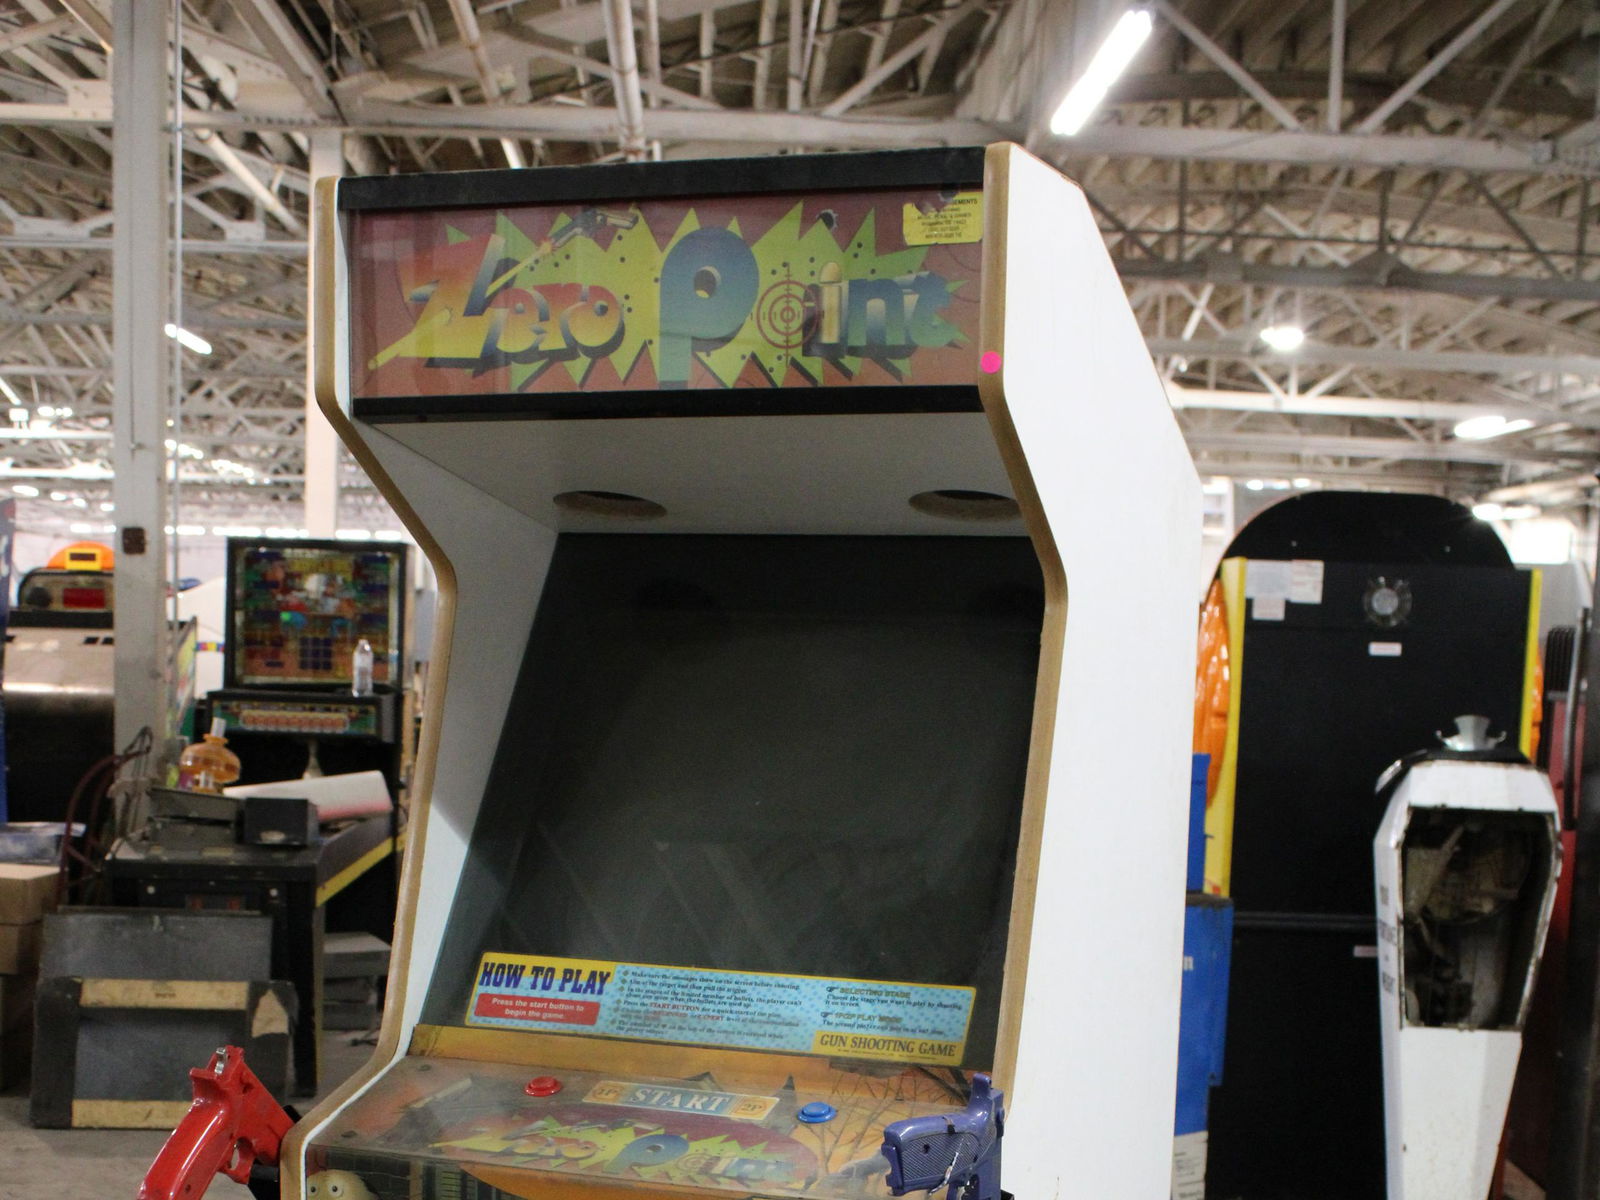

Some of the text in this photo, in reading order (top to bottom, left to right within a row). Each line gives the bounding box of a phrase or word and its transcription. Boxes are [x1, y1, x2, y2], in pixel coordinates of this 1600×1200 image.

[479, 962, 610, 995] HOW TO PLAY
[839, 987, 883, 996] SELECTING
[492, 998, 513, 1006] Press
[504, 1009, 527, 1017] begin
[820, 1034, 848, 1048] GUN
[850, 1036, 915, 1053] SHOOTING
[918, 1042, 956, 1057] GAME
[632, 1088, 730, 1111] START
